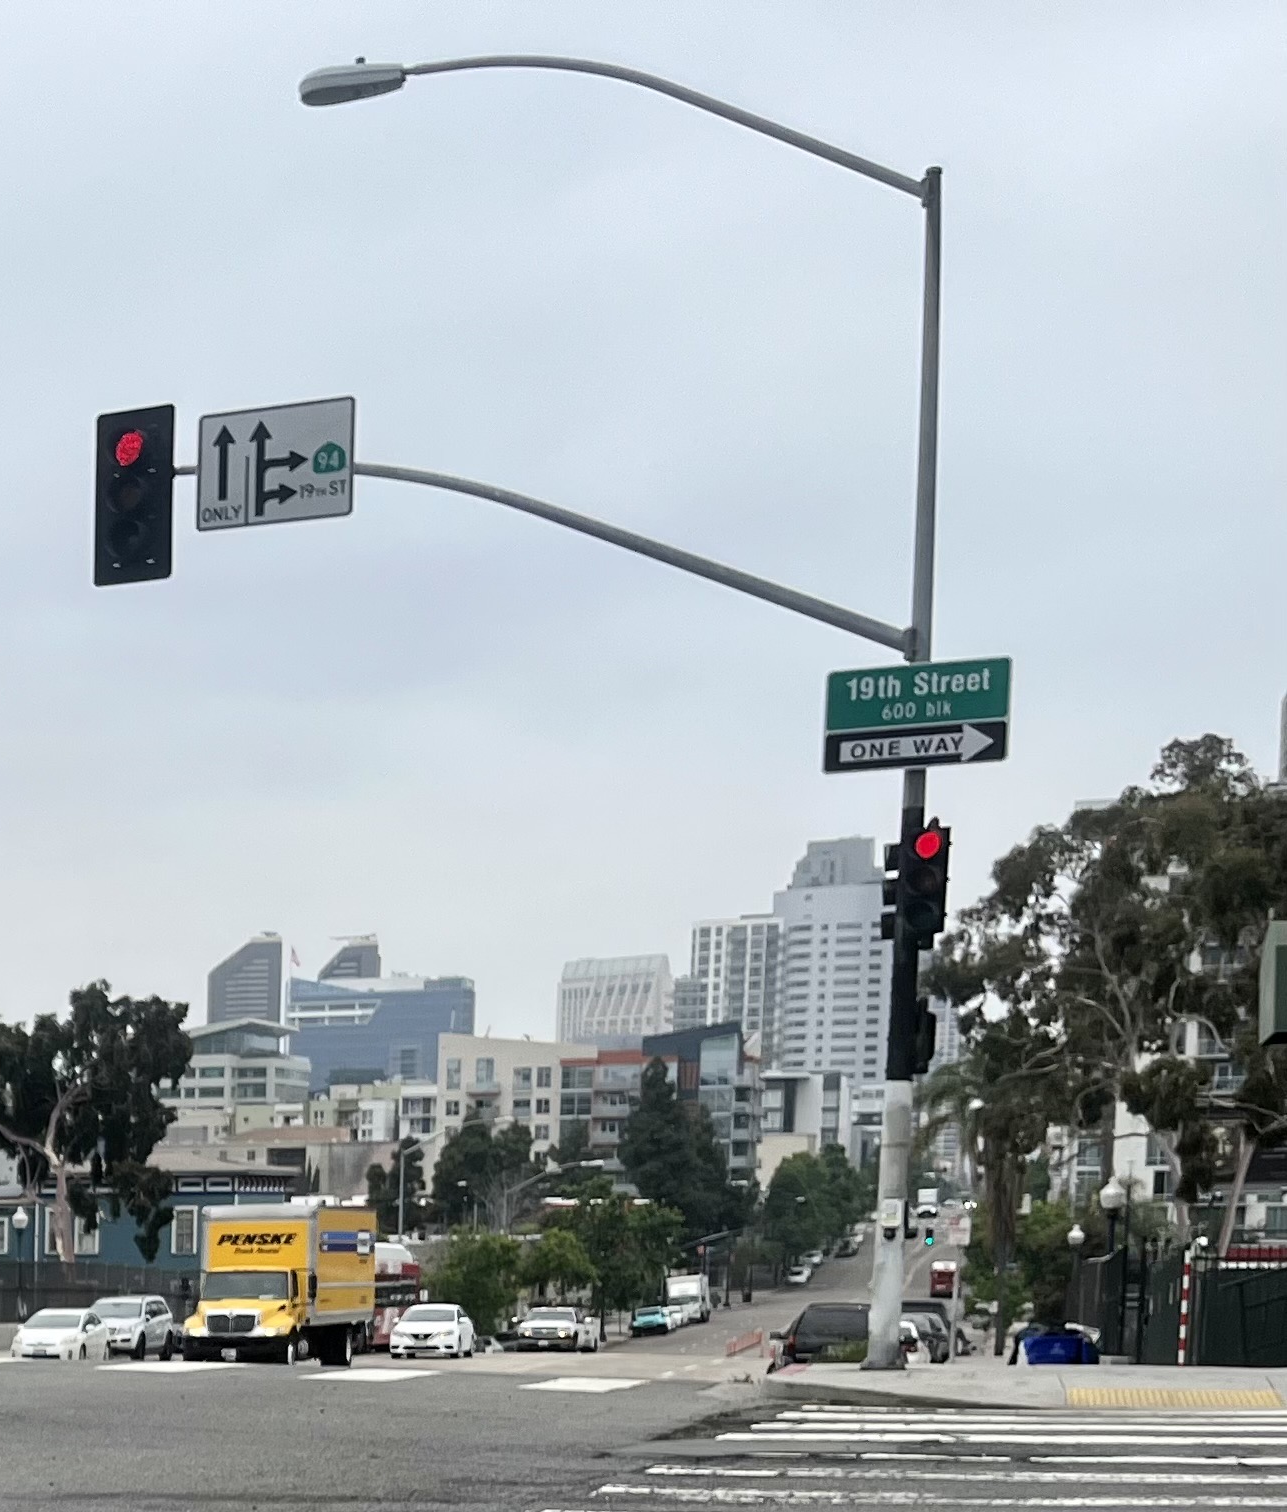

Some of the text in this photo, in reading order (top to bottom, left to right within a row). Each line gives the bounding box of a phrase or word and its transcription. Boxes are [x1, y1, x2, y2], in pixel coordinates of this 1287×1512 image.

[317, 450, 339, 470] 94
[329, 479, 346, 496] ST
[201, 505, 242, 522] ONLY
[846, 668, 990, 700] 19th Street
[881, 701, 951, 720] 600 blk
[850, 735, 963, 759] ONE WAY
[216, 1232, 297, 1246] PENSKE
